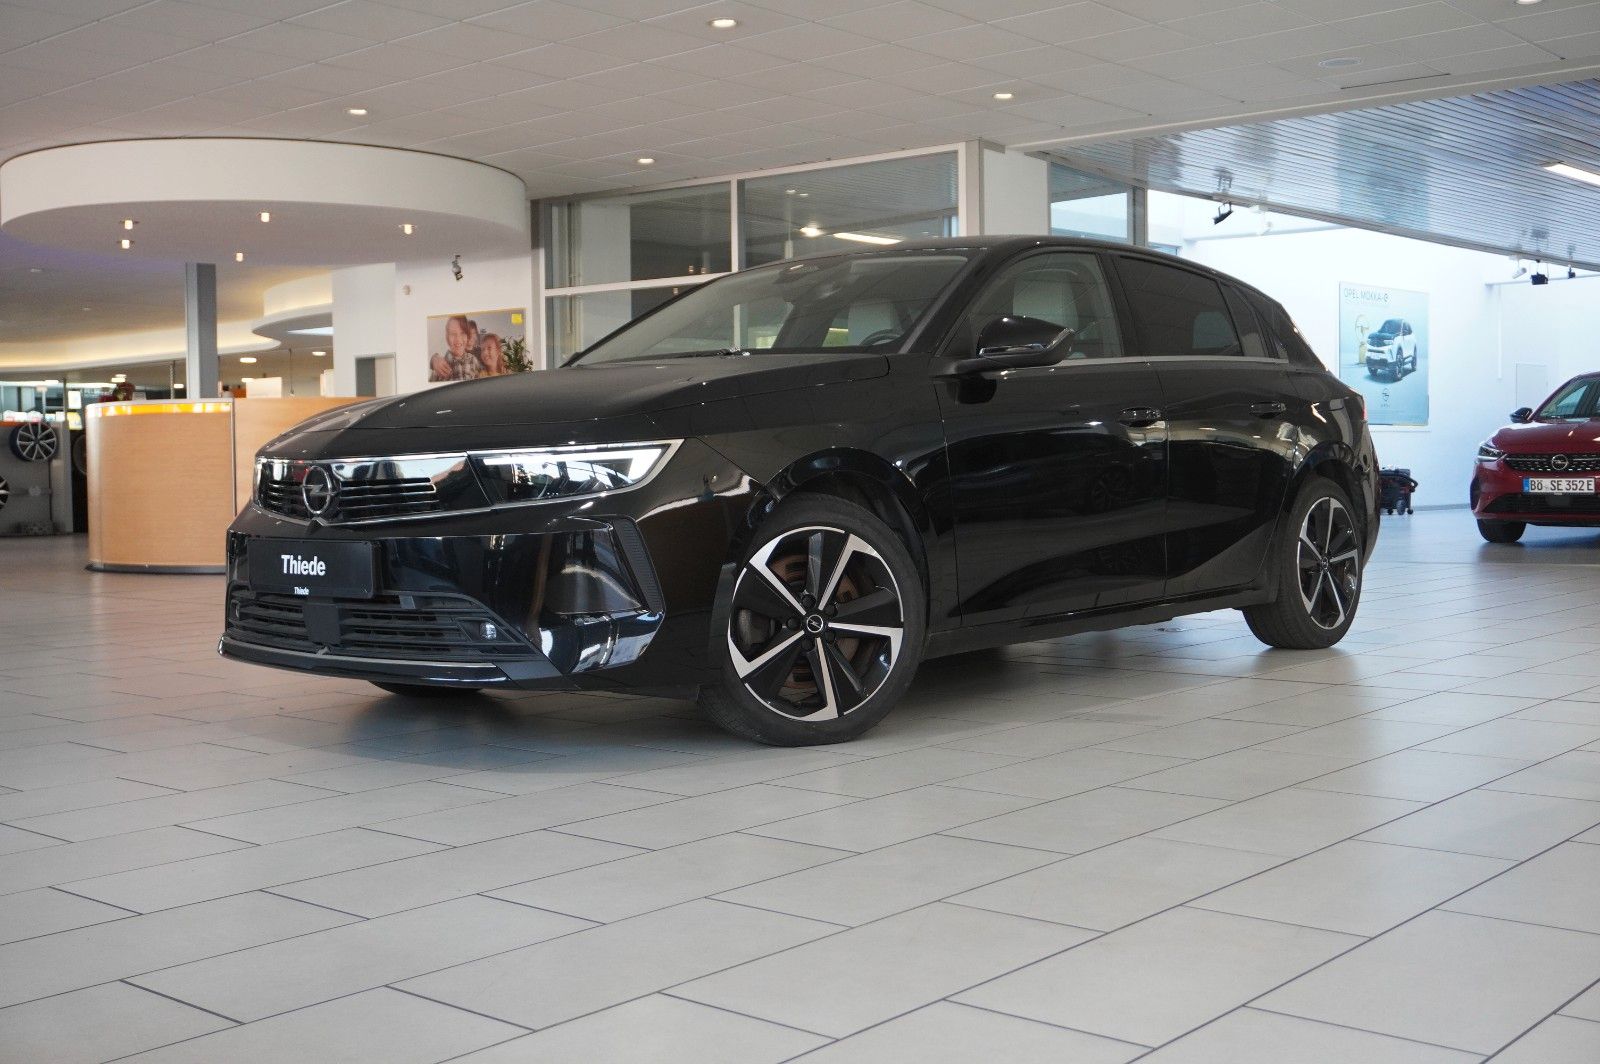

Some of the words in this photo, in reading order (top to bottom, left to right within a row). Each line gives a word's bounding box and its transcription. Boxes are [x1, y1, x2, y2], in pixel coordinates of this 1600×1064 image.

[1344, 287, 1360, 299] OPEL
[1550, 480, 1563, 491] SE
[281, 554, 326, 576] Thiede
[294, 586, 310, 596] Thiede
